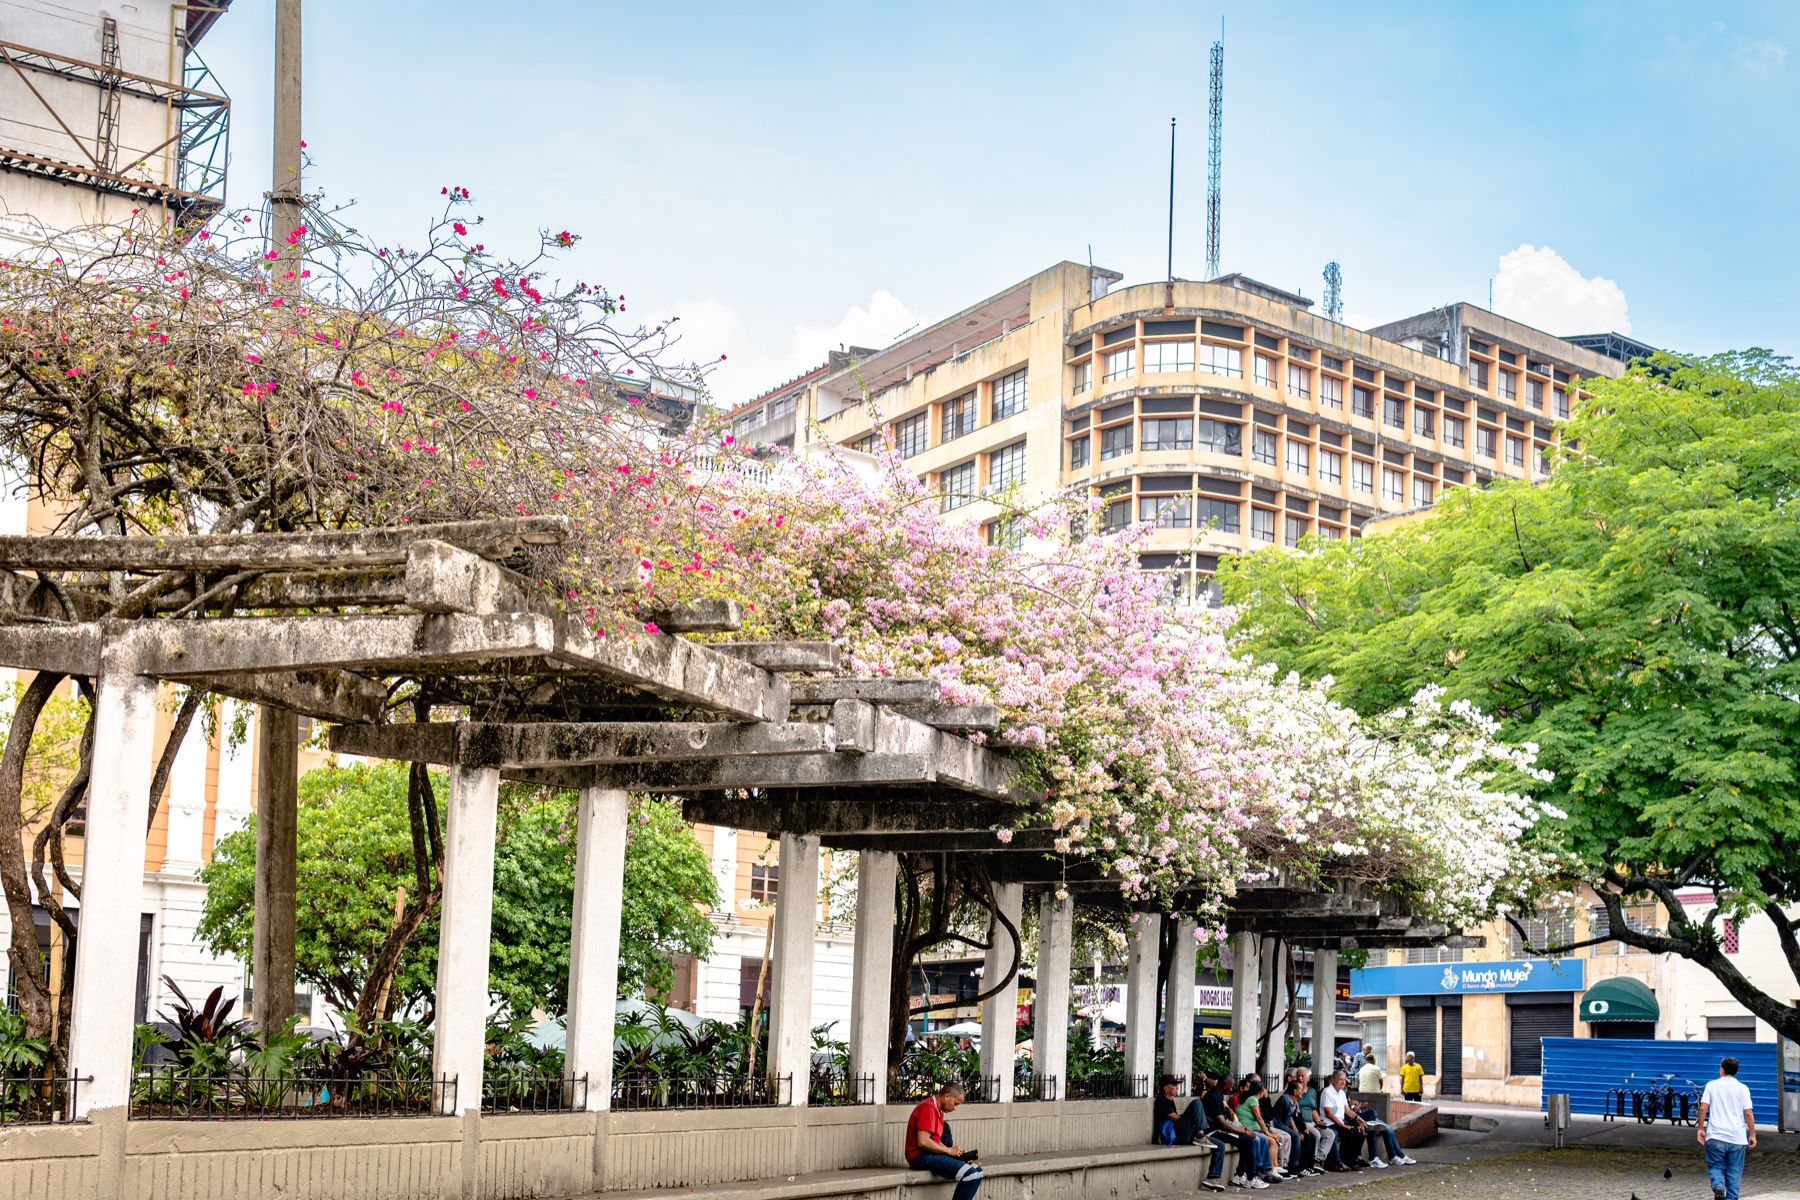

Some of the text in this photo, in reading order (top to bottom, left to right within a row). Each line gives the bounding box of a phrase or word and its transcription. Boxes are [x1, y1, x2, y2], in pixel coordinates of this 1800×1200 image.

[1462, 968, 1530, 985] Mundo Mujer
[1200, 990, 1220, 1006] DROGAS
[1221, 990, 1226, 1007] LA
